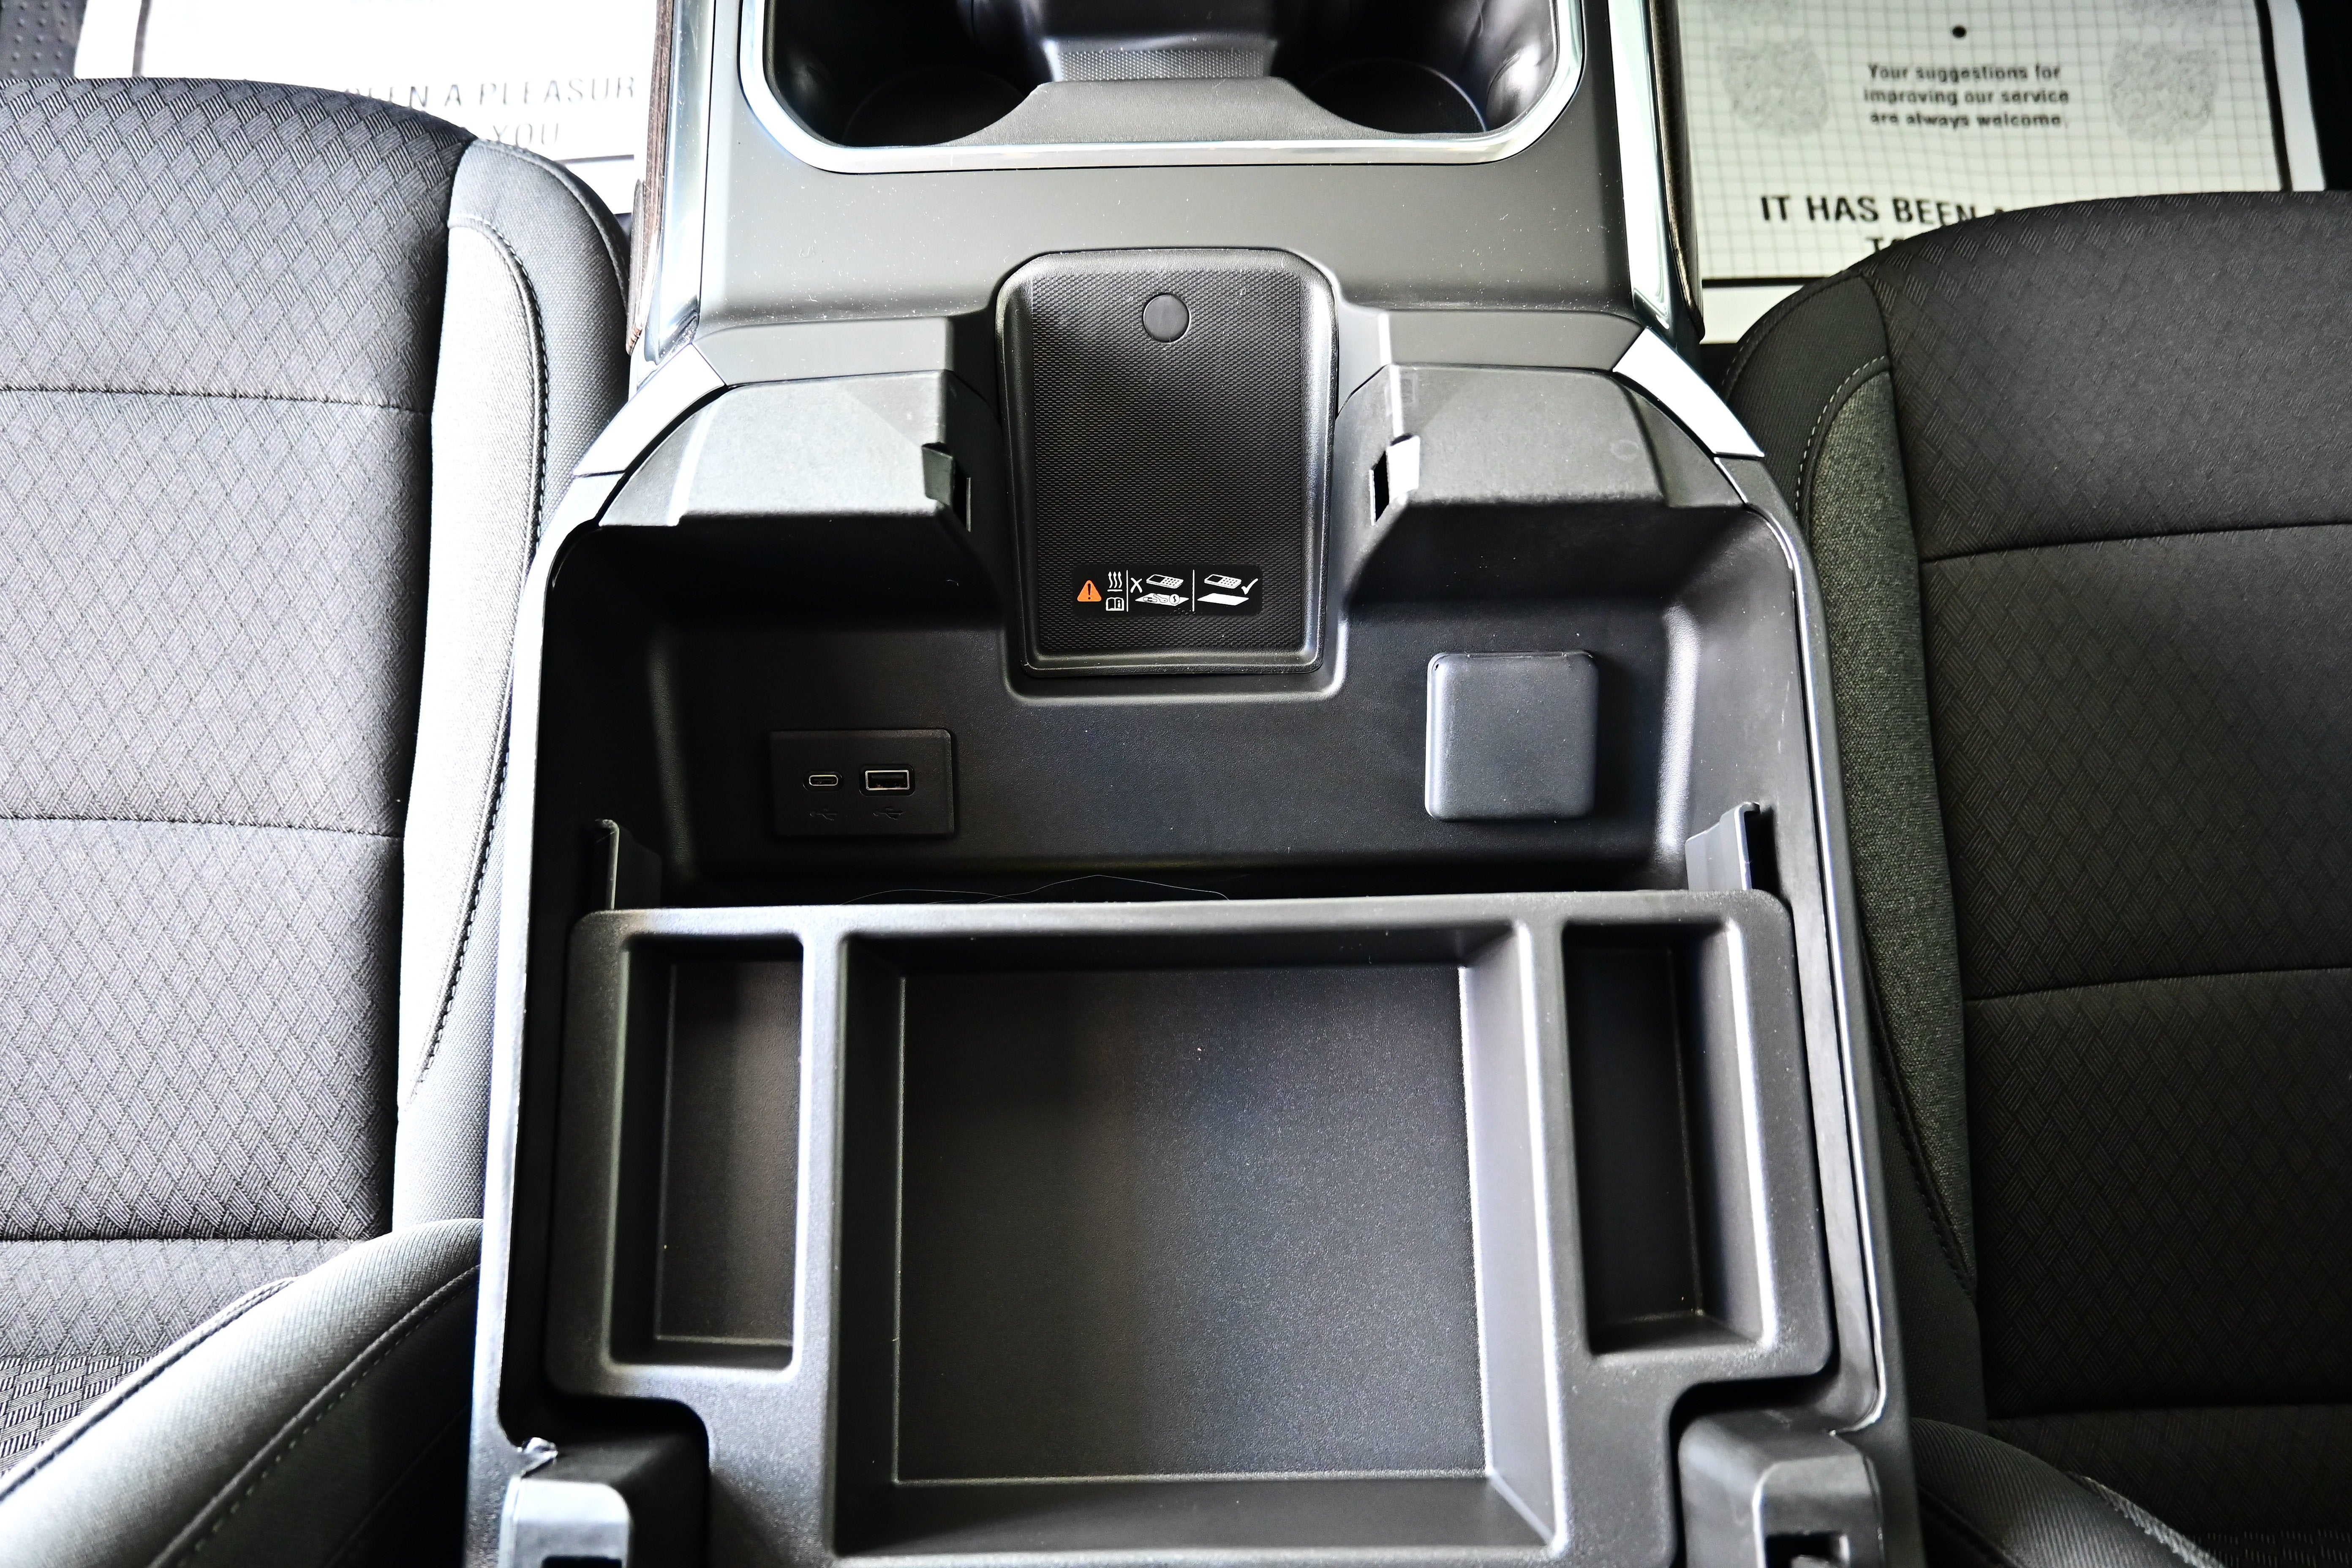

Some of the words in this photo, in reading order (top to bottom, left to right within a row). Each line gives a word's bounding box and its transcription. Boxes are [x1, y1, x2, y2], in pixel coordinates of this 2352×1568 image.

[1867, 64, 1908, 79] Your
[1916, 66, 2028, 83] suggestions
[2034, 63, 2061, 79] for
[444, 84, 462, 107] A
[1863, 89, 1958, 106] improving
[1964, 91, 1994, 103] our
[2001, 88, 2069, 103] service
[1870, 112, 1898, 124] are
[1906, 112, 1970, 130] always
[1760, 195, 1791, 221] IT
[1806, 195, 1879, 222] HAS
[1892, 197, 1978, 227] BEEN
